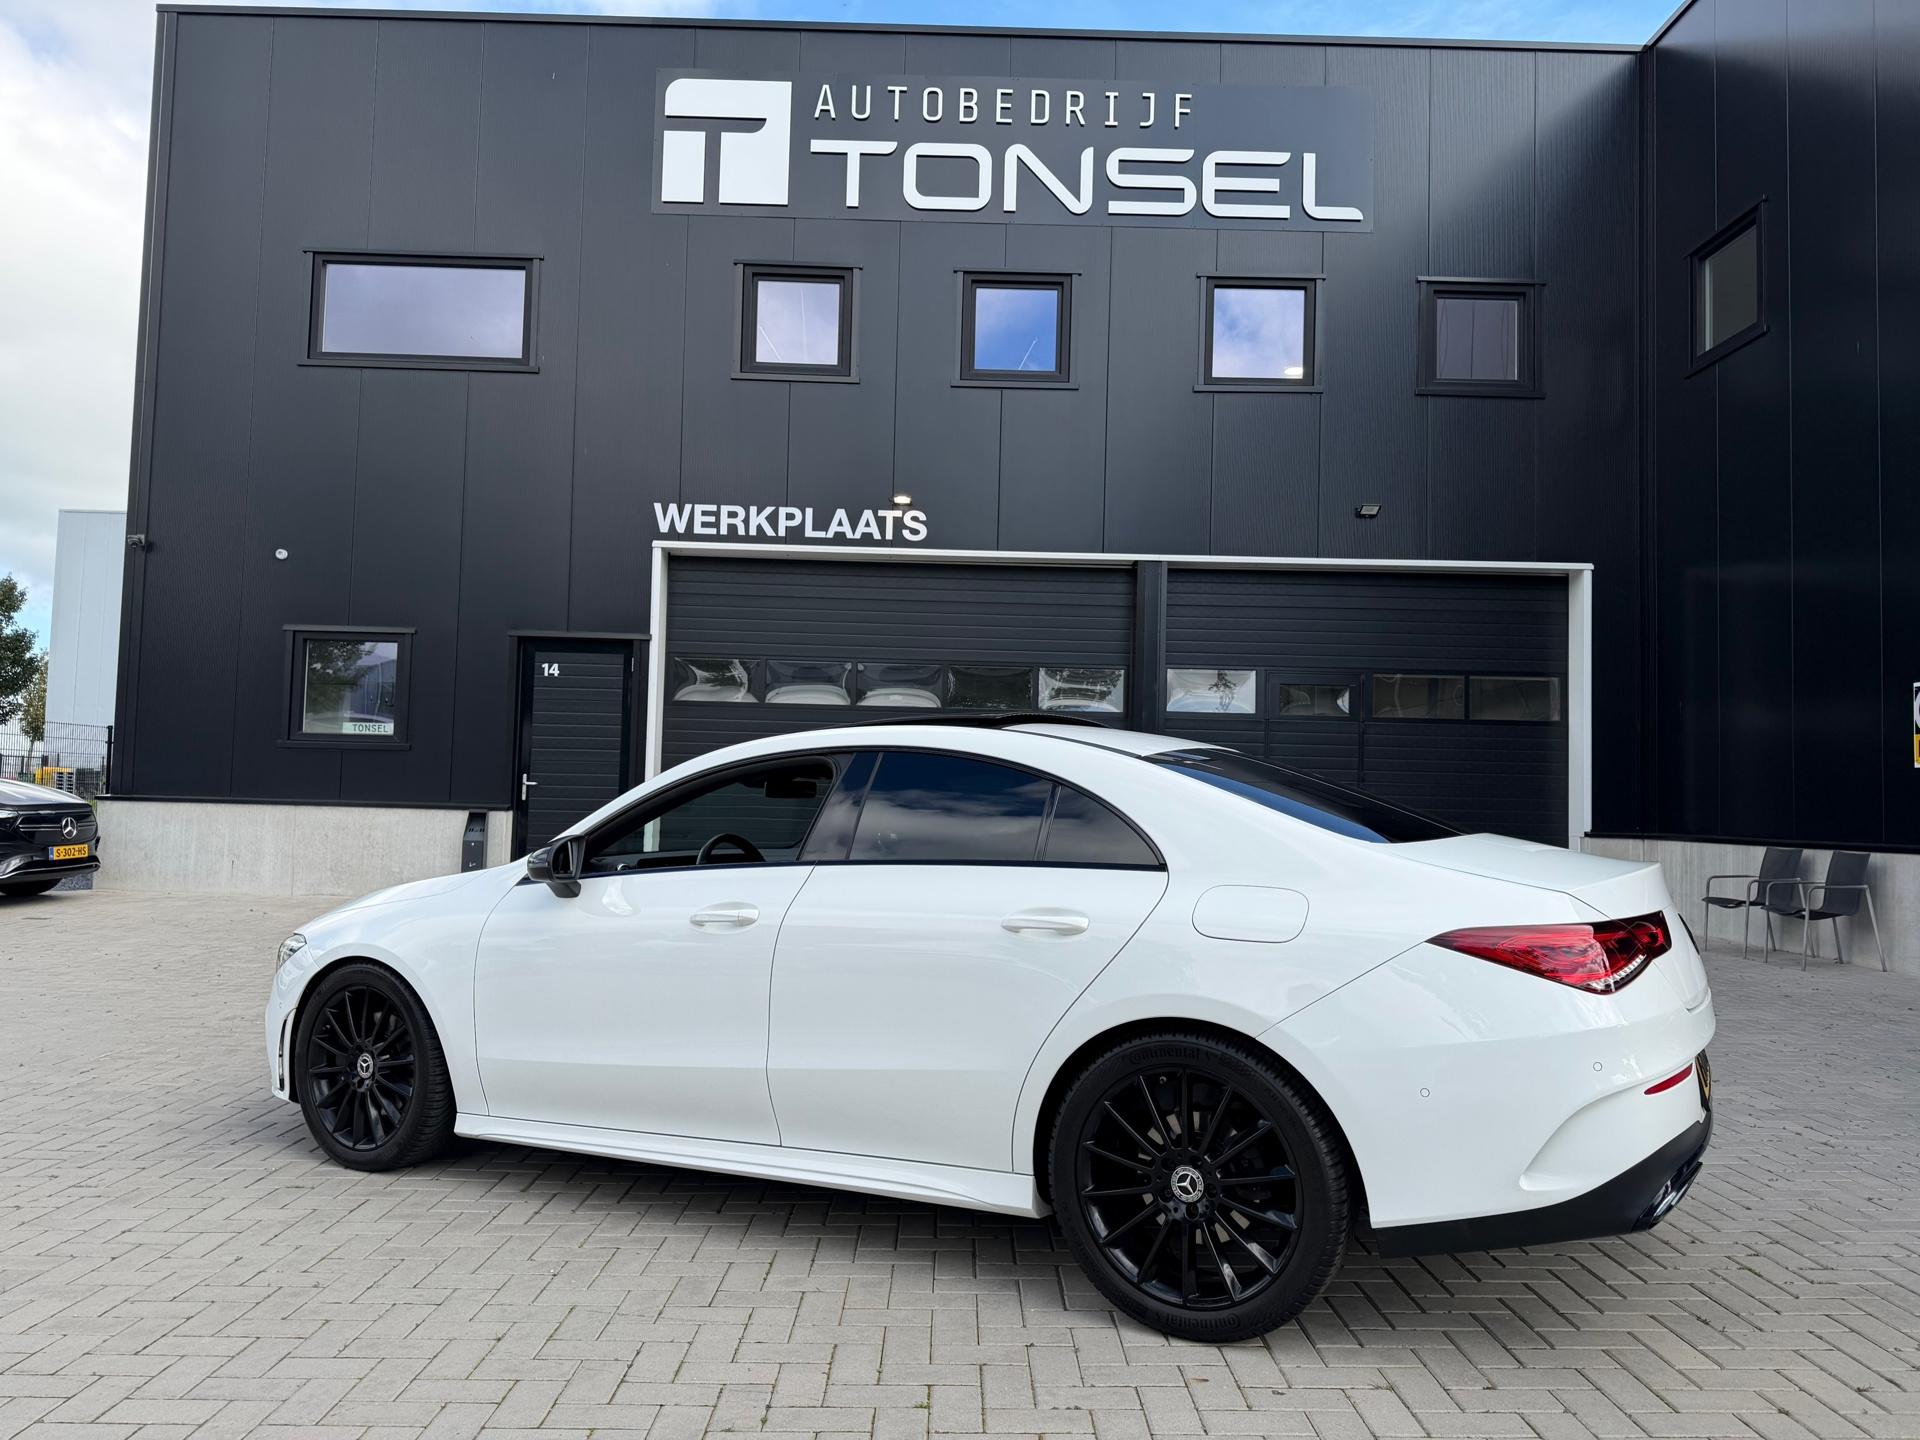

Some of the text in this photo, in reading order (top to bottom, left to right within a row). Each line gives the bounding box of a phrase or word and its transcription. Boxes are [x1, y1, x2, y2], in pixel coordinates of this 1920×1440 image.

[814, 84, 1194, 129] AUTOBEDRIJF
[809, 138, 1364, 222] TONSEL
[653, 502, 928, 542] WERKPLAATS
[541, 662, 560, 677] 14
[352, 723, 389, 733] TONSEL
